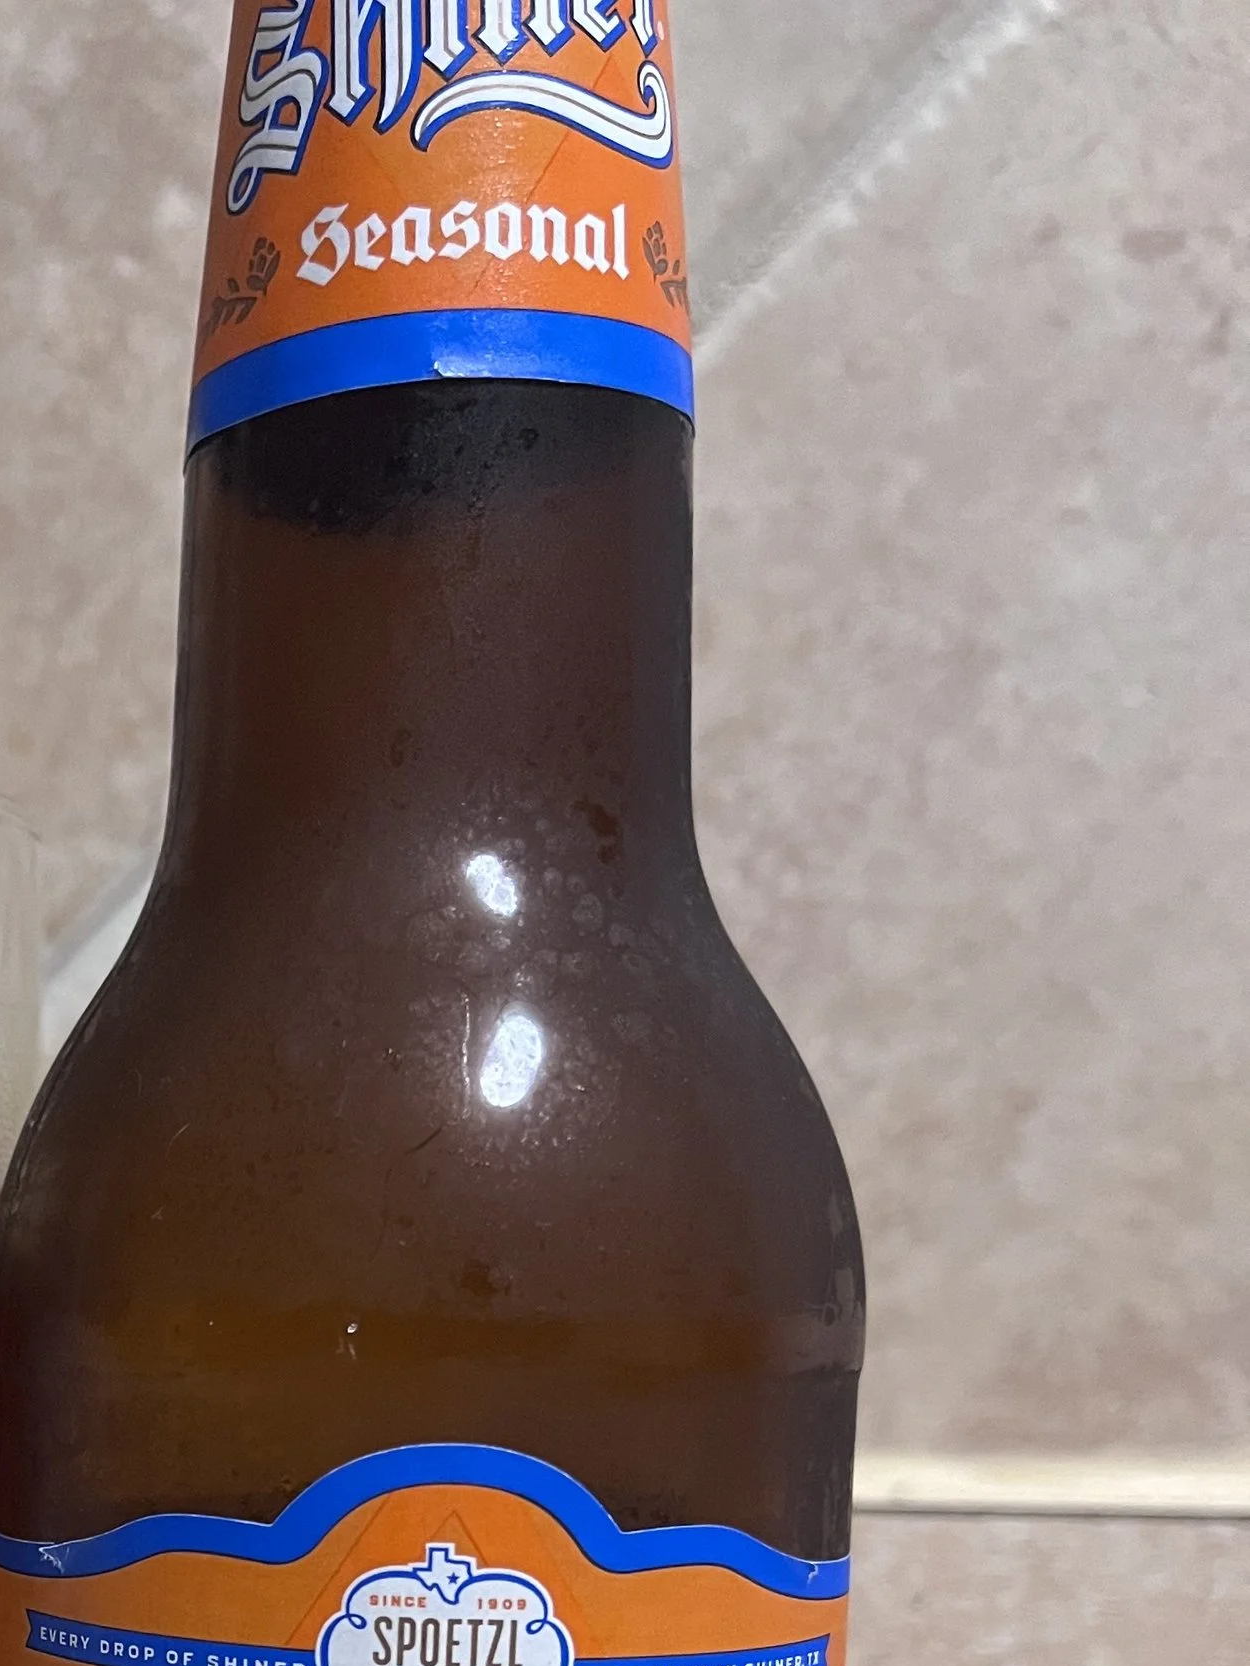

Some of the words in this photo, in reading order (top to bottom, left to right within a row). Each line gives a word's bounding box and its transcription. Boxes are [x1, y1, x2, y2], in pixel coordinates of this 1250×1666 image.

[295, 199, 631, 287] Seasonal
[369, 1594, 427, 1608] SINCE
[478, 1597, 527, 1610] 1909
[39, 1625, 91, 1651] EVERY
[99, 1638, 155, 1661] DROP
[165, 1650, 194, 1666] OF
[806, 1649, 821, 1666] TX
